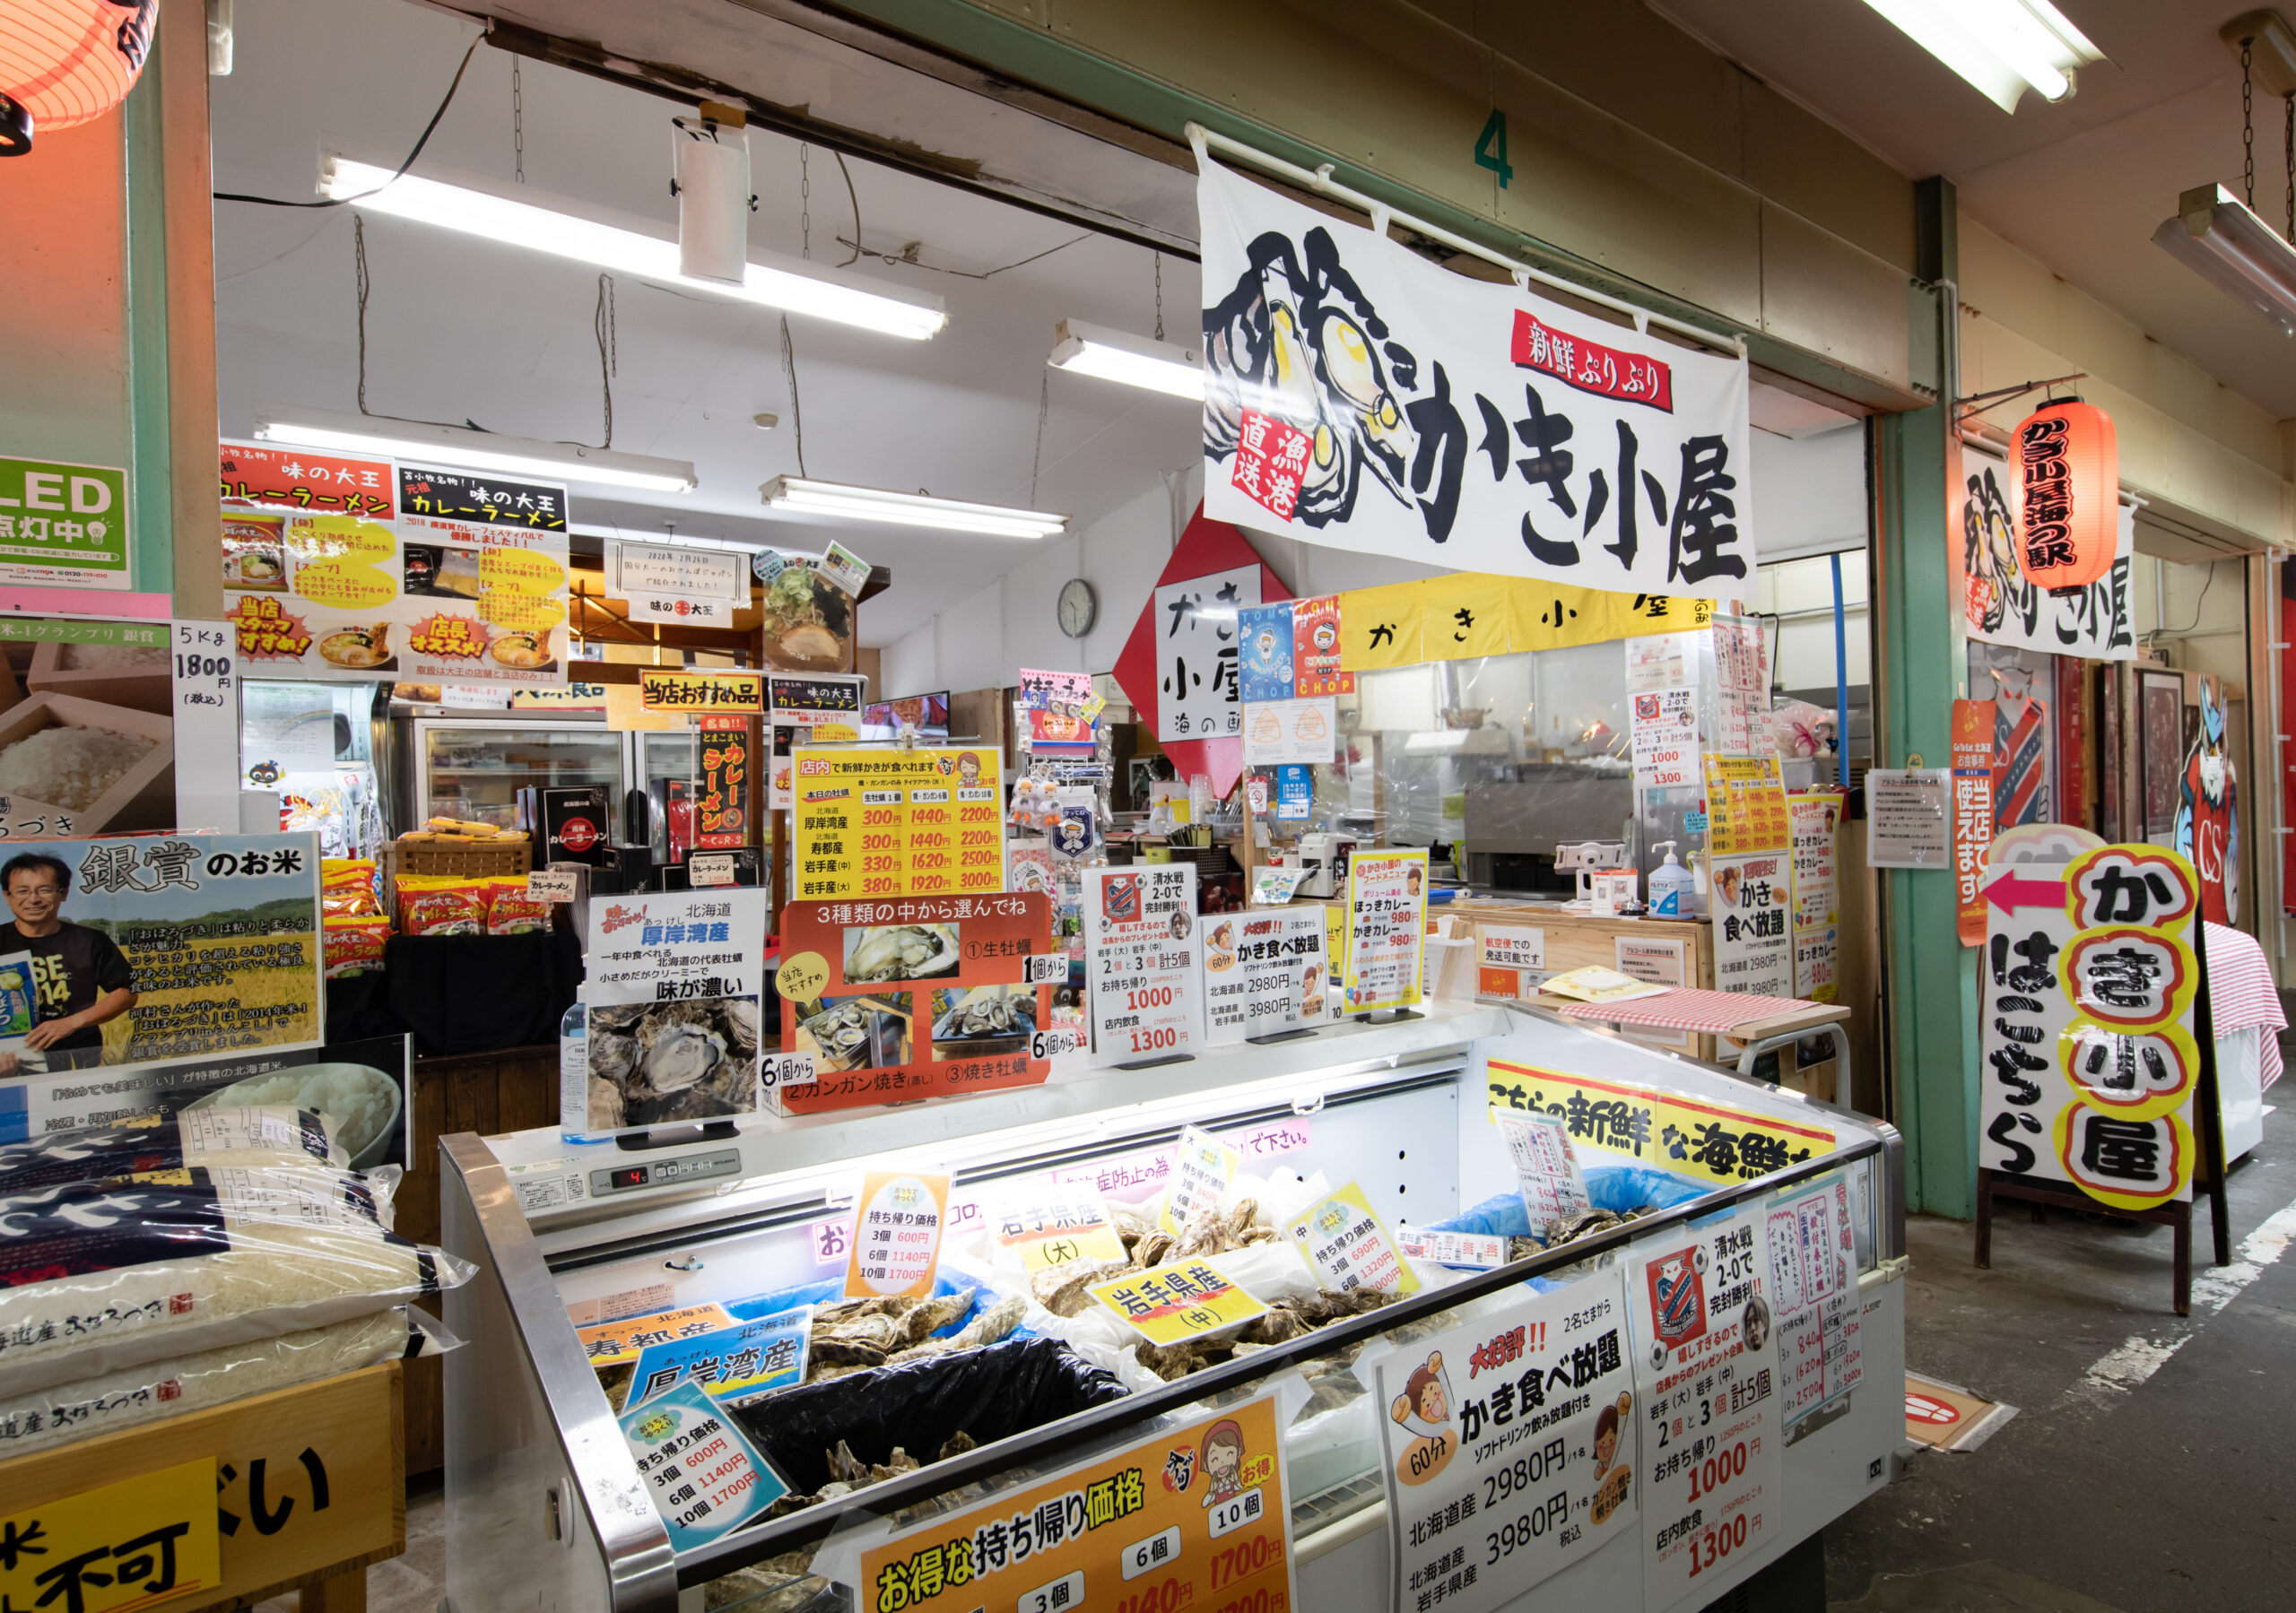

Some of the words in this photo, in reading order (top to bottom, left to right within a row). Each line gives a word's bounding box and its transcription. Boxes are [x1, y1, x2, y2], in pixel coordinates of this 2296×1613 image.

[1474, 108, 1514, 189] 4
[1528, 322, 1660, 402] 新鮮ぷりぷり
[282, 465, 380, 489] 味の大王
[1406, 360, 1747, 585] かき小屋
[405, 483, 430, 495] 元祖
[470, 489, 555, 512] 味の大王
[406, 516, 425, 526] 2018
[413, 496, 564, 527] カレーラーメン
[241, 596, 279, 618] 当店
[1242, 608, 1288, 622] TOMA
[124, 629, 154, 644] 銀賞
[430, 614, 468, 637] 店長
[176, 654, 230, 679] 1800
[219, 679, 230, 689] 円
[644, 678, 760, 705] 当店おすすめ品
[807, 687, 852, 698] 味の大王
[1244, 686, 1290, 698] CHOP
[1300, 681, 1349, 694] CHOP
[778, 697, 857, 708] カレーラーメン
[703, 733, 744, 742] とまこまい
[722, 742, 745, 806] カレー
[800, 759, 935, 776] 店内で新鮮かきが食べれます
[700, 749, 721, 831] ラーメン
[804, 817, 848, 829] 厚岸湾産
[863, 810, 901, 826] 300円
[911, 809, 951, 824] 1440円
[960, 807, 998, 822] 2200円
[549, 831, 607, 845] カレーラーメン
[861, 834, 900, 850] 300円
[910, 833, 951, 847] 1440円
[961, 830, 998, 846] 2200円
[1956, 779, 1977, 904] 使えます
[862, 855, 901, 872] 330円
[912, 853, 952, 869] 1620円
[961, 850, 999, 866] 2500円
[862, 877, 901, 893] 380円
[911, 874, 952, 890] 1920円
[960, 872, 999, 888] 3000円
[1152, 872, 1184, 885] 清水戦
[1152, 886, 1183, 899] 2-0で
[1741, 880, 1771, 908] かき
[686, 903, 732, 918] 北海道
[816, 900, 1028, 924] 3種類の中から選んでね
[1354, 899, 1410, 913] ほっきカレー
[641, 922, 729, 946] 厚岸湾産
[1353, 924, 1400, 938] かきカレー
[1724, 909, 1785, 941] 食べ放題
[1238, 934, 1319, 962] かき食べ放題
[1485, 936, 1531, 950] 航空便での
[601, 949, 672, 961] 一年中食べれる
[1160, 951, 1190, 968] 計5個
[1213, 955, 1231, 968] 60分
[1485, 950, 1540, 965] 発送可能です
[1751, 953, 1777, 970] 2980円
[599, 967, 709, 983] 小さめだがクリーミーで
[1024, 956, 1066, 981] 1個から
[657, 977, 743, 1001] 味が濃い
[1101, 976, 1147, 993] お持ち帰り
[1211, 983, 1245, 996] 北海道産
[1248, 974, 1290, 993] 2980円
[129, 998, 239, 1019] 河村さんが作った
[1127, 986, 1172, 1010] 1000
[1211, 1004, 1239, 1015] 北海道産
[1249, 997, 1290, 1018] 3980円
[1105, 1015, 1140, 1029] 店内飲食
[1215, 1014, 1245, 1026] 岩手県産
[2086, 864, 2174, 1182] かき小屋
[1131, 1028, 1176, 1053] 1300
[1987, 931, 2059, 1173] はこちら
[761, 1056, 814, 1083] 6個から
[631, 1171, 639, 1183] 4
[869, 1210, 937, 1227] 持ち帰り価格
[873, 1230, 891, 1242] 3個
[898, 1232, 929, 1244] 600円
[1316, 1218, 1376, 1263] 持ち帰り価格
[1714, 1225, 1753, 1260] 清水戦
[869, 1250, 887, 1262] 6個
[892, 1251, 930, 1263] 1140円
[1330, 1257, 1350, 1275] 3個
[1352, 1236, 1380, 1261] 690円
[1361, 1251, 1395, 1279] 1320円
[860, 1268, 885, 1279] 10個
[889, 1269, 926, 1280] 1700円
[1717, 1252, 1753, 1288] 2-0で
[1112, 1266, 1228, 1314] 岩手県産
[657, 1305, 718, 1322] 北海道
[1564, 1298, 1612, 1332] 2名さまから
[736, 1314, 799, 1342] 北海道
[1677, 1322, 1738, 1364] 嬉しすぎるので
[1656, 1340, 1744, 1394] 店長からのプレゼント企画
[1459, 1328, 1622, 1444] かき食べ放題
[1731, 1367, 1772, 1411] 計5個
[1475, 1393, 1591, 1464] ソフトドリンク飲み放題付き
[653, 1465, 683, 1487] 3個
[685, 1437, 728, 1470] 600円
[1410, 1435, 1446, 1477] 60分
[1654, 1434, 1716, 1483] お持ち帰り
[668, 1484, 697, 1507] 6個
[697, 1453, 749, 1489] 1140円
[674, 1500, 713, 1529] 10個
[711, 1469, 762, 1508] 1700円
[1409, 1492, 1477, 1548] 北海道産
[1484, 1438, 1565, 1509] 2980円
[1216, 1492, 1261, 1530] 10個
[876, 1466, 1145, 1613] お得な持ち帰り価格
[1487, 1491, 1569, 1566] 3980円
[1560, 1524, 1582, 1548] 税込
[1657, 1508, 1702, 1551] 店内飲食
[1135, 1535, 1169, 1568] 6個
[1210, 1534, 1283, 1584] 1700円
[1409, 1546, 1465, 1592] 北海道産
[1417, 1565, 1477, 1613] 岩手県産
